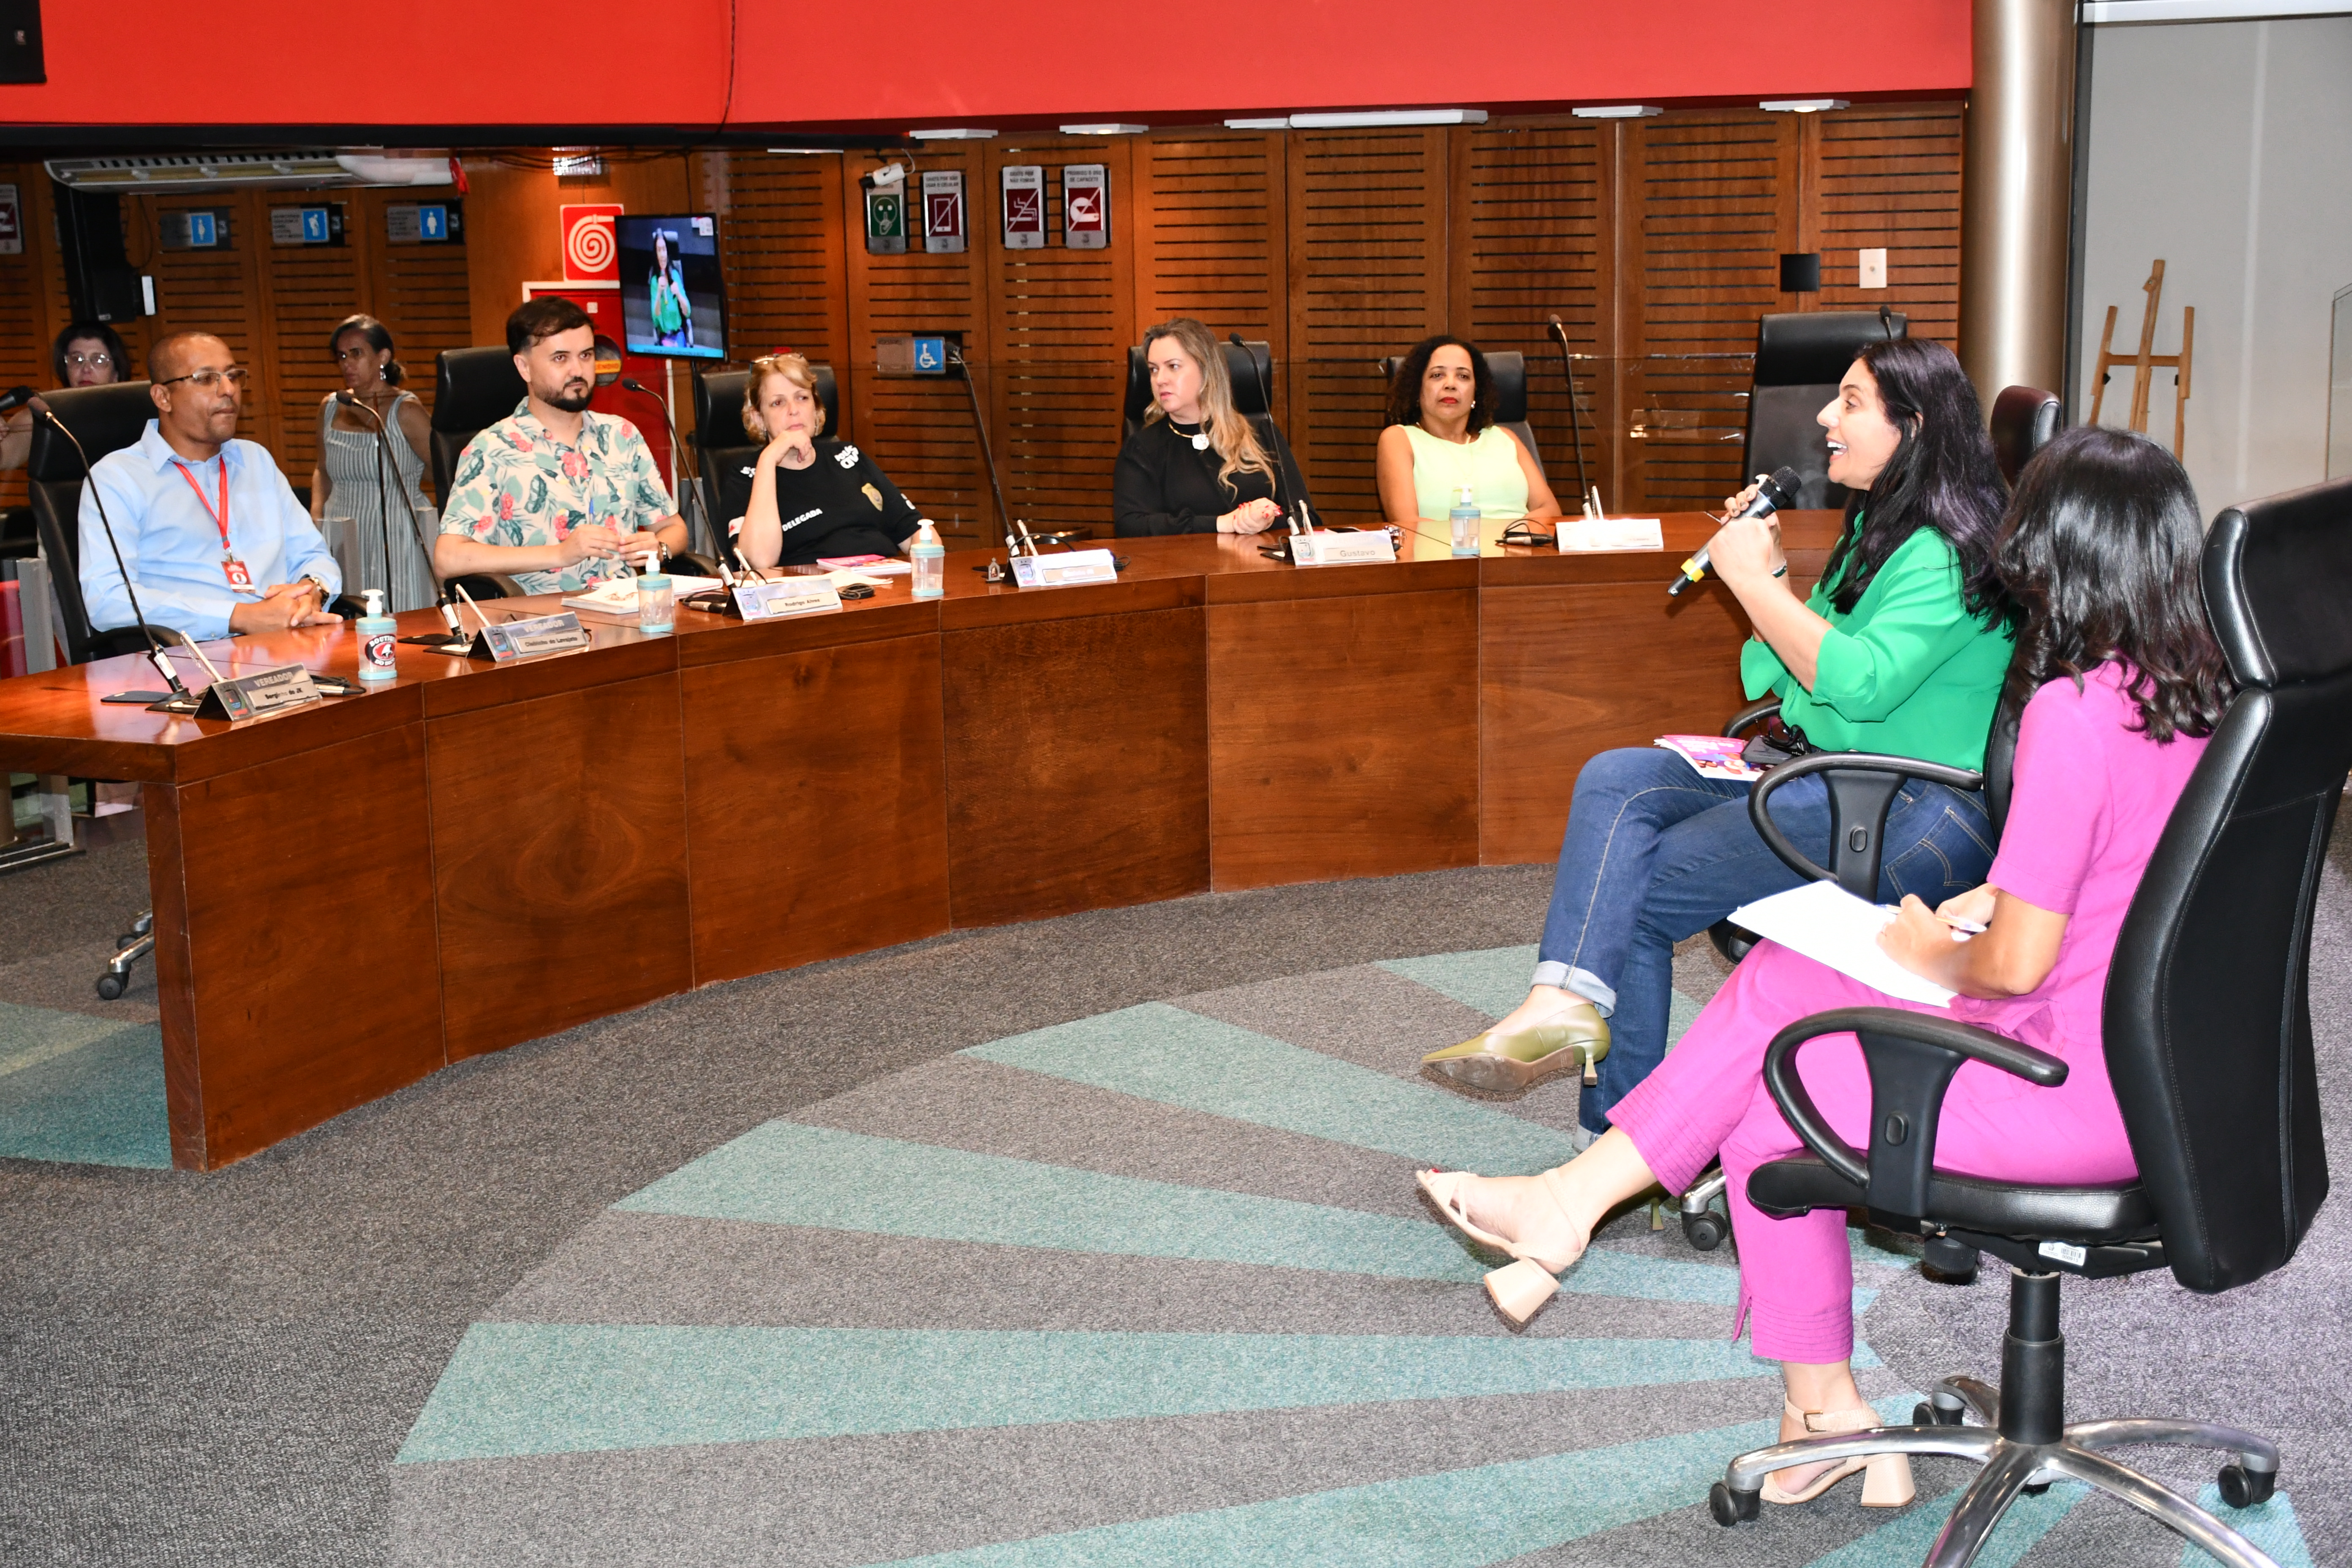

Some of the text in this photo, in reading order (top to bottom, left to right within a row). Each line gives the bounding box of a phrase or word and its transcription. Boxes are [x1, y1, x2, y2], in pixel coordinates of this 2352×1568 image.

[782, 508, 823, 532] DELEGADA
[524, 620, 565, 632] VEREADOR
[254, 672, 294, 687] VEREADOR
